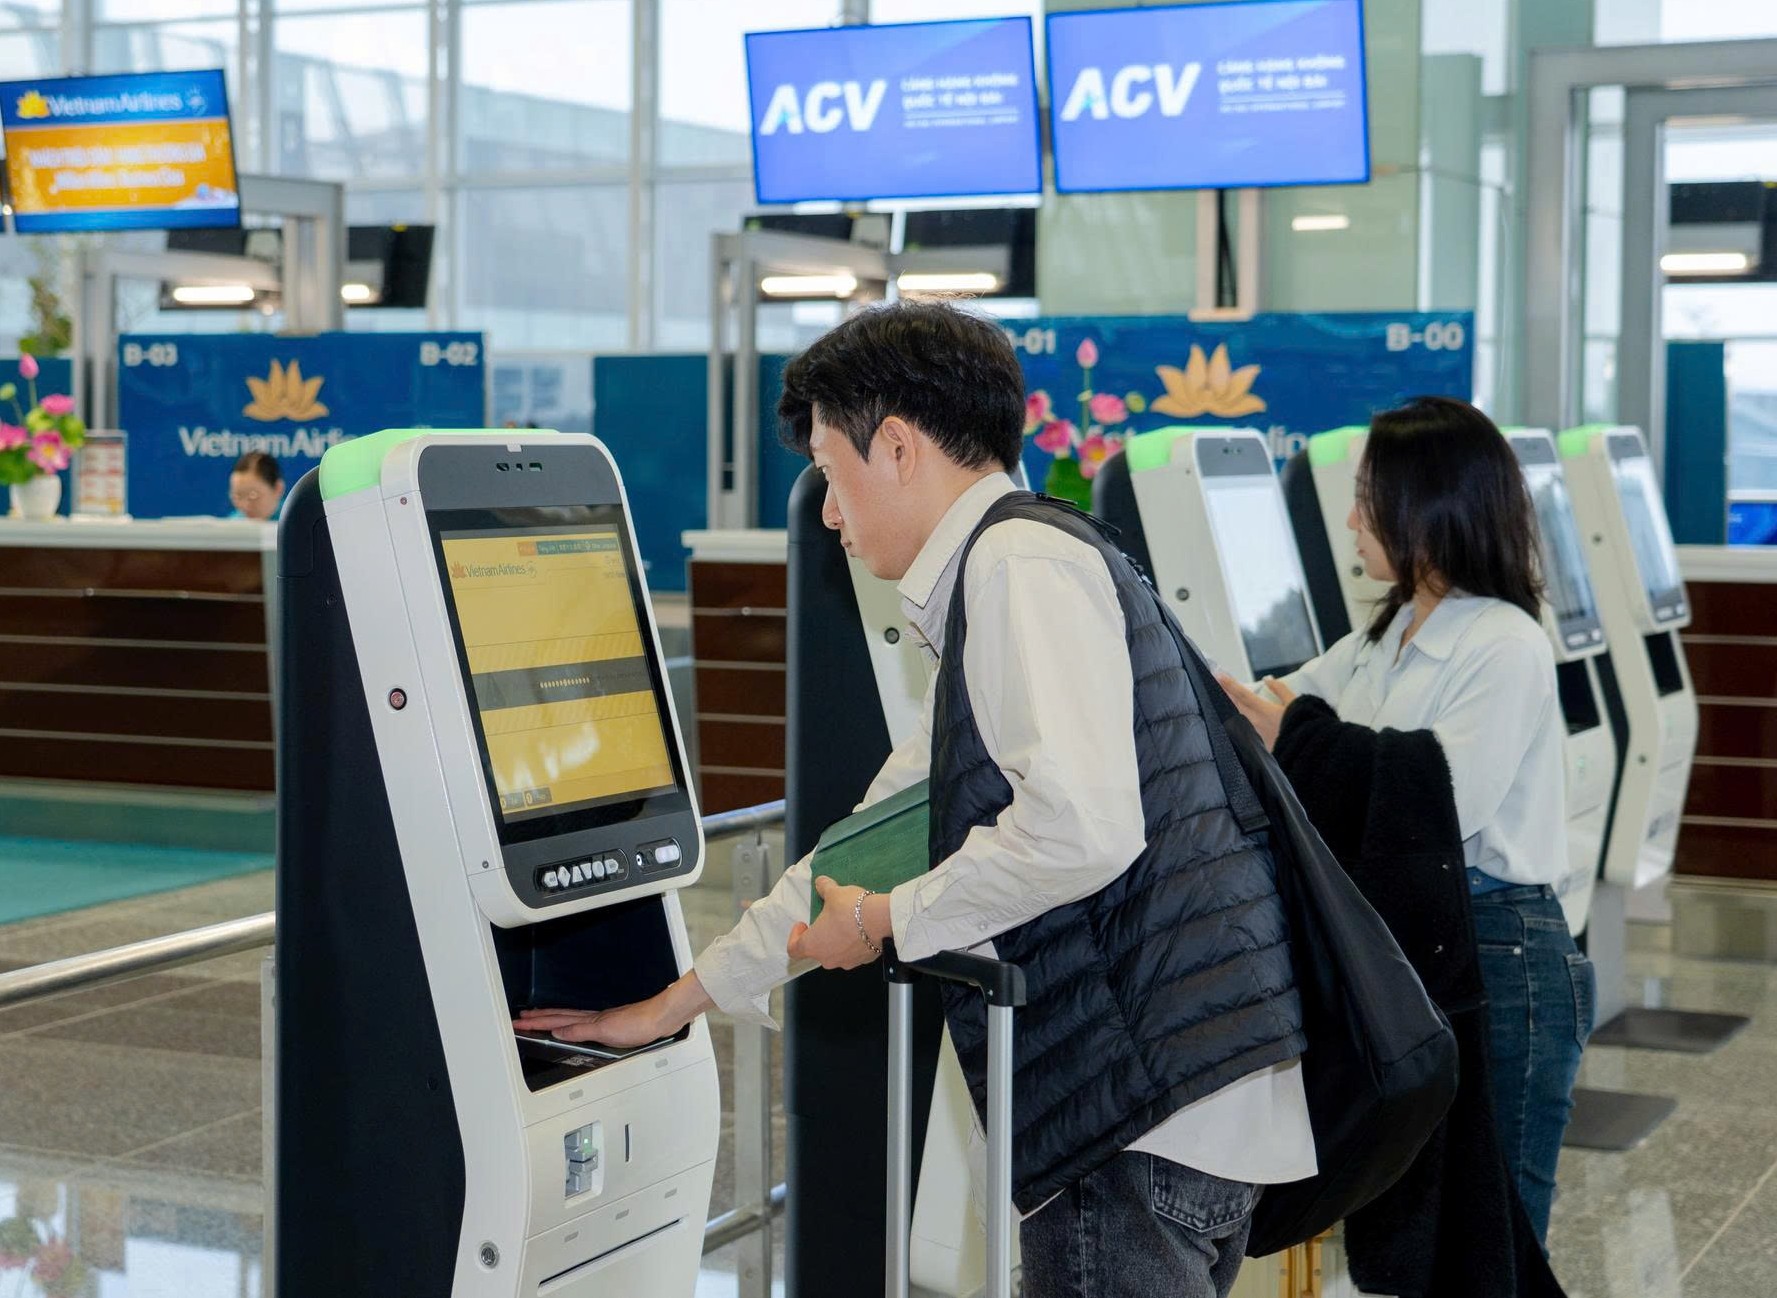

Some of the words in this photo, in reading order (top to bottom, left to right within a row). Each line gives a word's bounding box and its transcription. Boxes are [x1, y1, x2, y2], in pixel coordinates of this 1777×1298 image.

[760, 79, 887, 136] ACV
[1060, 62, 1201, 122] ACV
[1386, 322, 1464, 351] B-00
